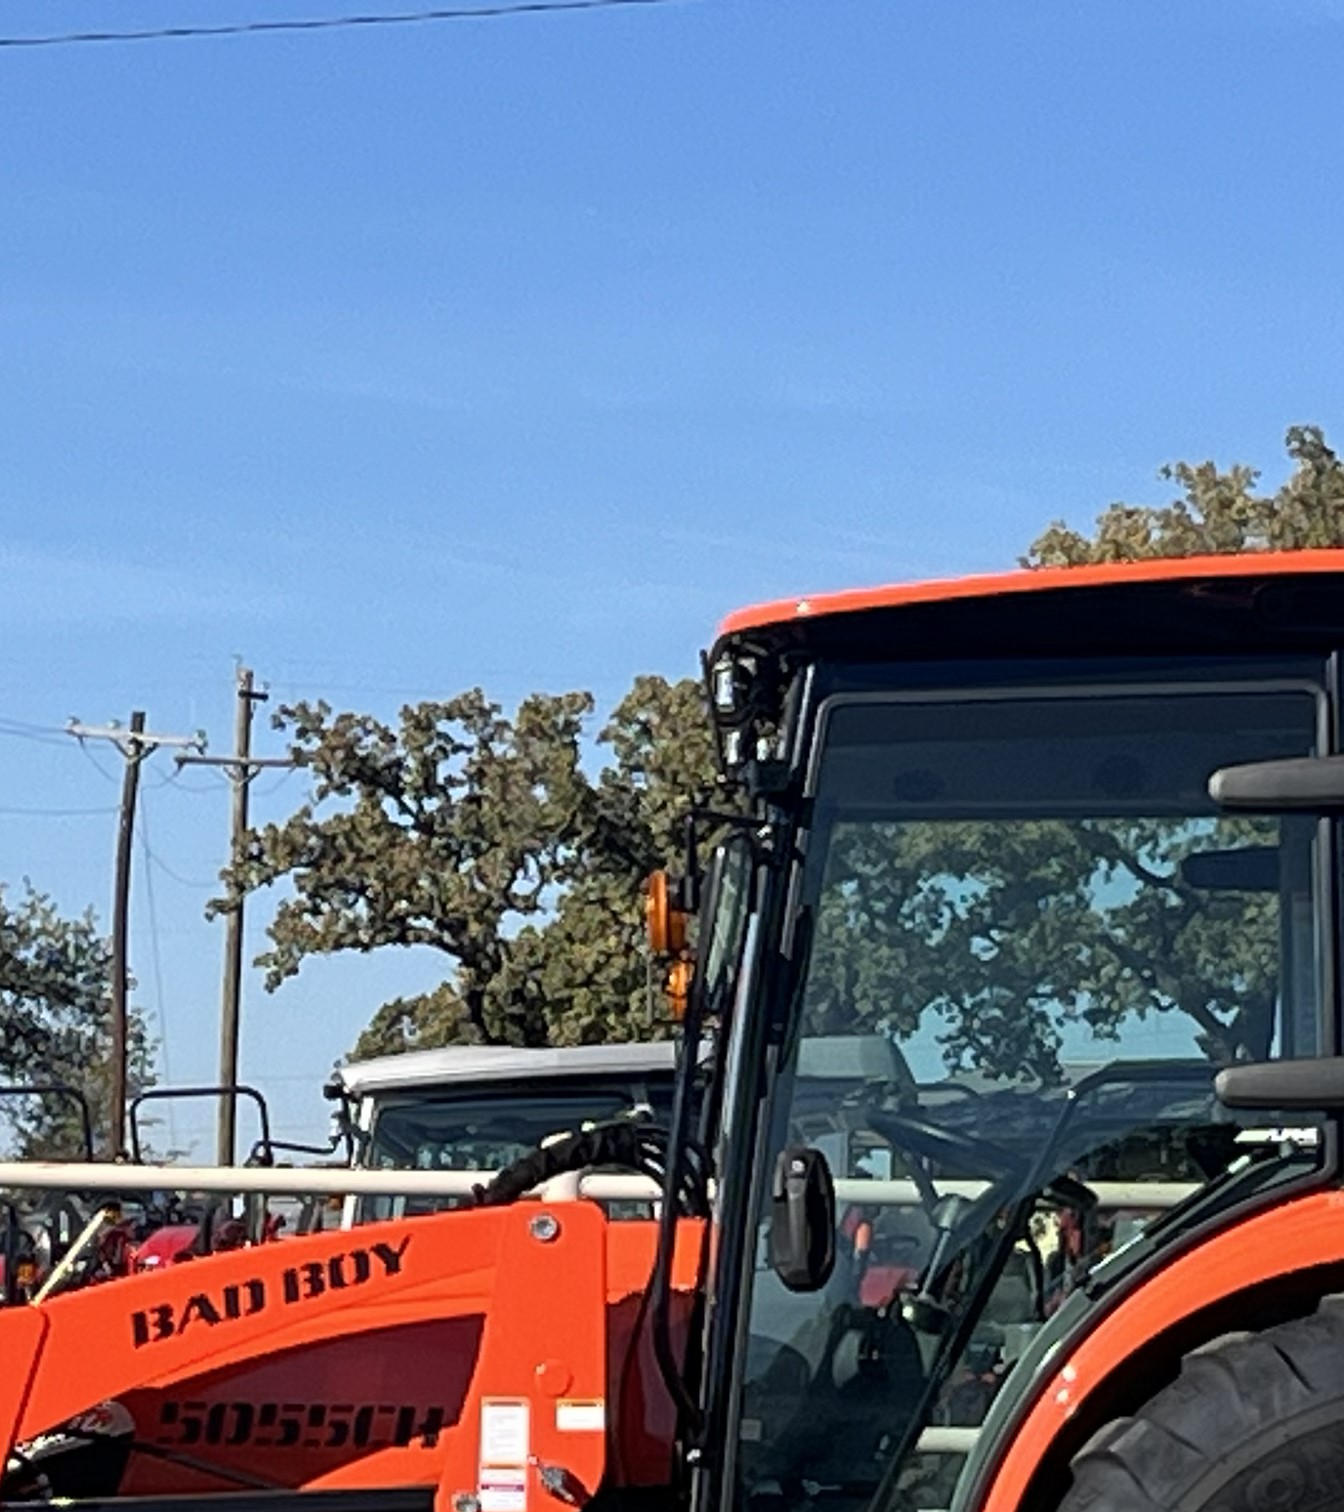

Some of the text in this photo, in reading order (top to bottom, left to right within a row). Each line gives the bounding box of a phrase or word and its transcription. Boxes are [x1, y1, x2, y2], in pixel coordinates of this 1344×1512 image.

[131, 1234, 413, 1349] BAD BOY
[156, 1402, 445, 1449] 5055CH
